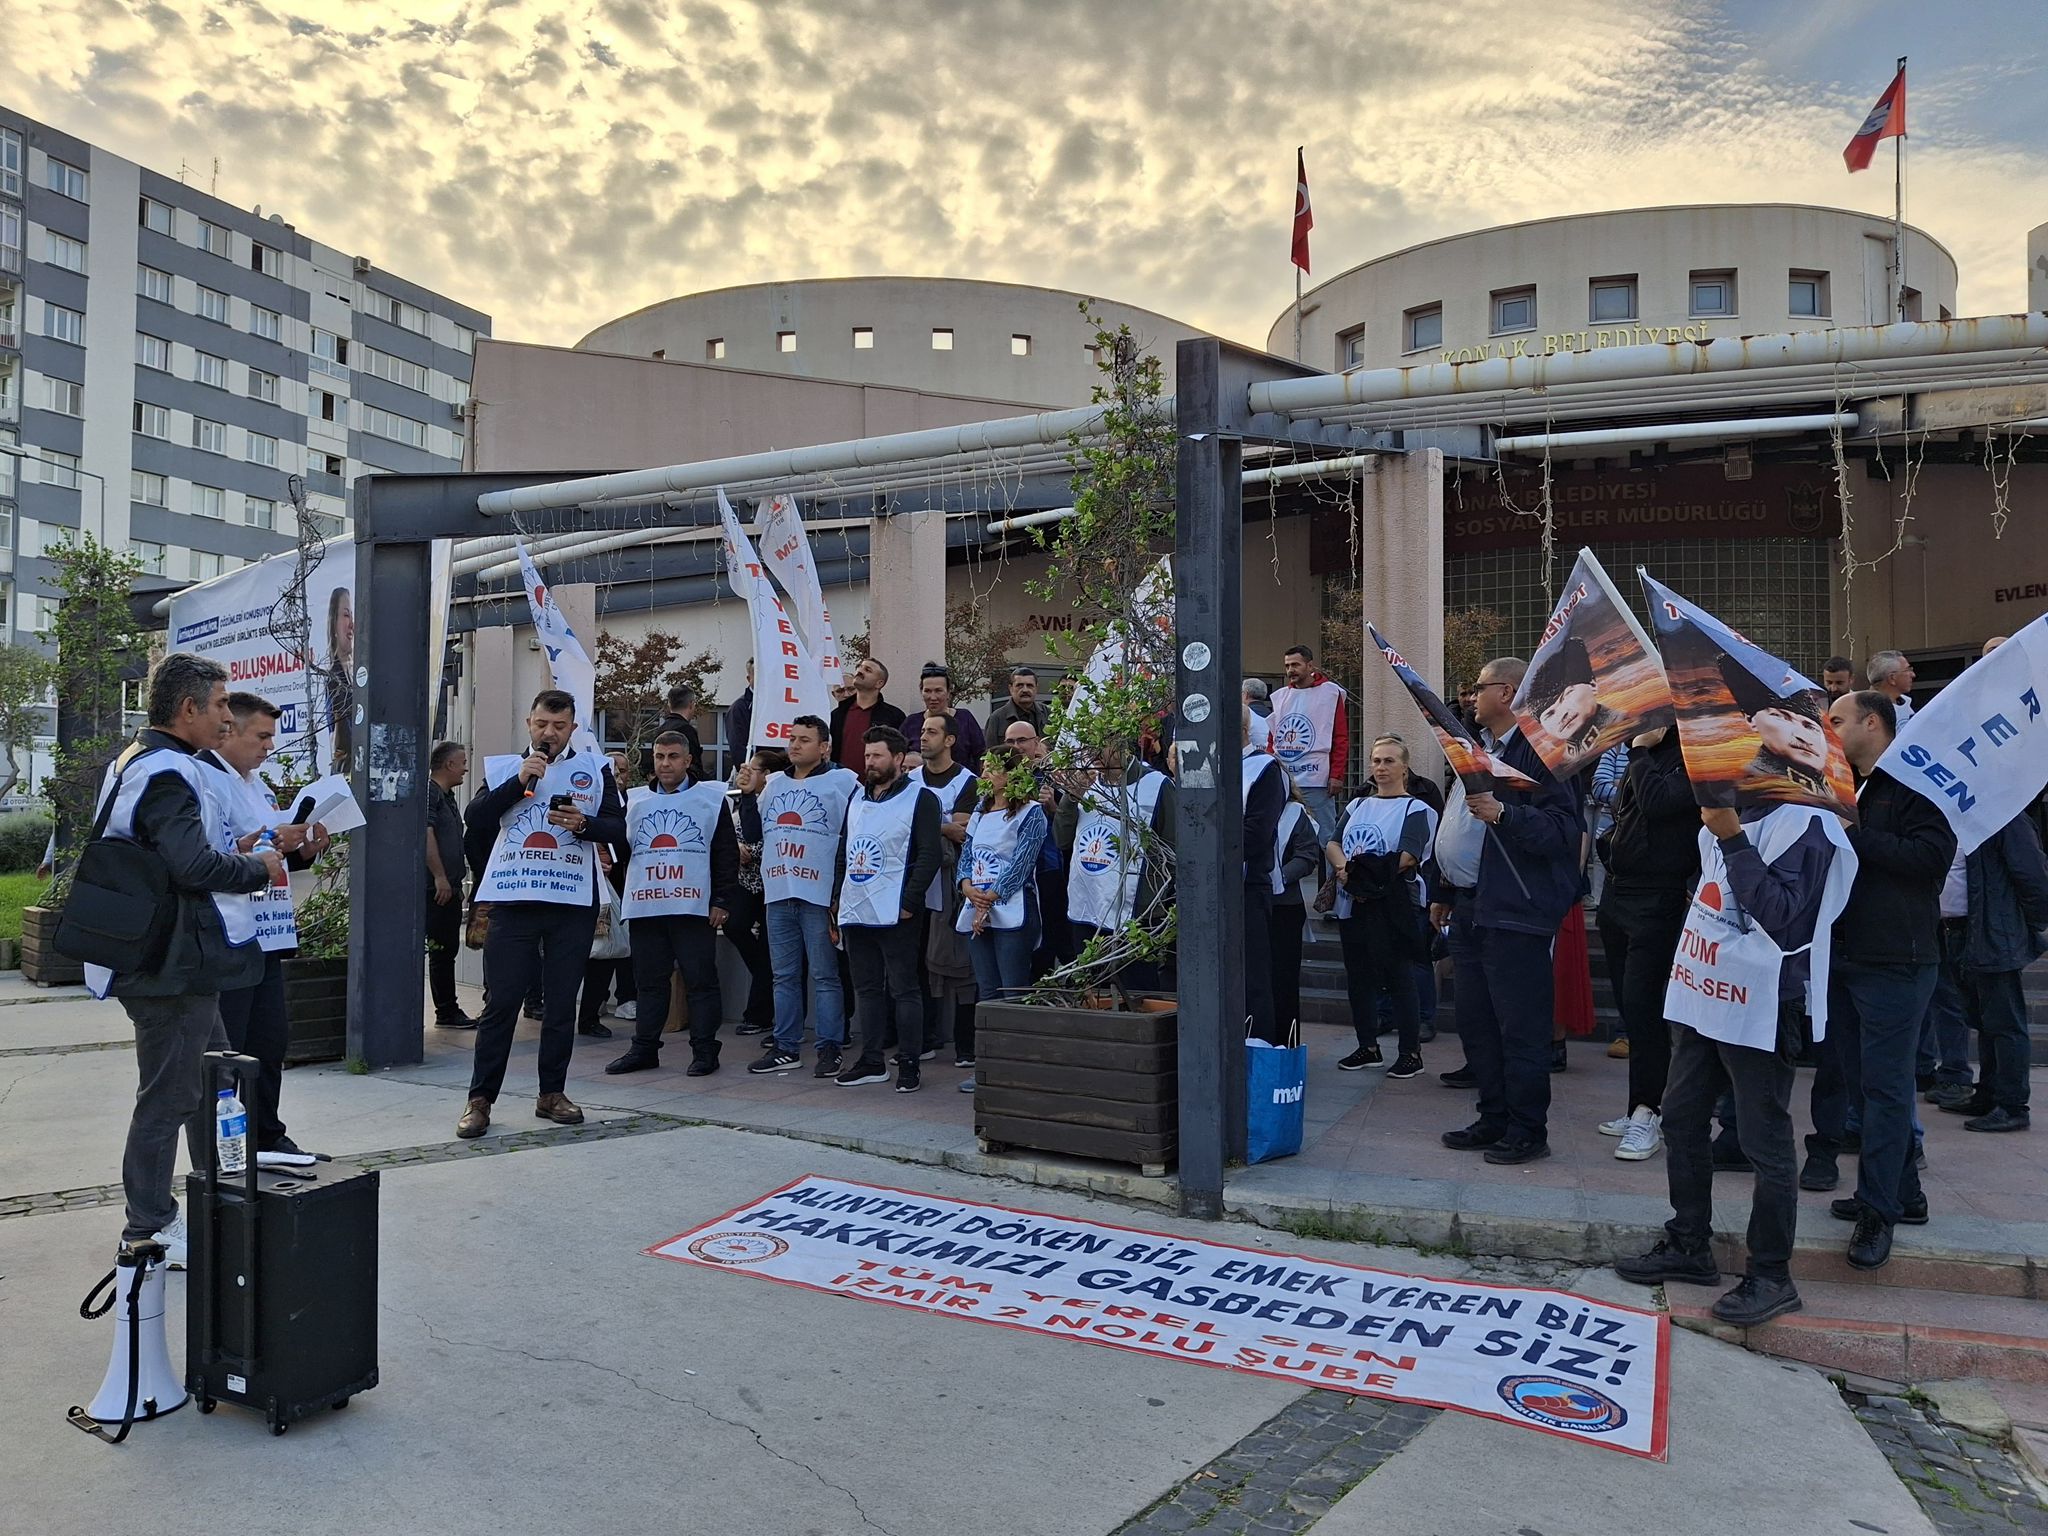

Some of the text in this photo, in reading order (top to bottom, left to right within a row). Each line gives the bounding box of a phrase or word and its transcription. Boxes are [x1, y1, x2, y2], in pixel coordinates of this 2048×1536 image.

[1543, 320, 1709, 353] BELEDİYESİ
[1454, 499, 1767, 537] SOSYAL ŞLER MÜDÜRLÜĞÜ
[281, 709, 295, 730] 07
[1900, 744, 1977, 814] SEN
[500, 850, 516, 864] TÜM
[519, 850, 557, 861] YEREL
[564, 853, 584, 865] SEN
[776, 838, 806, 859] TÜM
[491, 867, 584, 882] Emek Hareketinde
[645, 862, 684, 881] TÜM
[496, 879, 577, 893] Güçlü Bir Mevzi
[631, 887, 701, 901] YEREL-SEN
[1681, 928, 1720, 966] TÜM
[1272, 1080, 1304, 1104] mavi
[772, 1187, 1638, 1353] ALINTERİ DÖKEN BİZ, EMEK VEREN BİZ,
[735, 1209, 1631, 1386] HAKKIMIZI GASBEDEN SİZ!
[856, 1259, 1417, 1371] TÜM YEREL SEN
[829, 1272, 1398, 1389] İZMİR 2 NOLU ŞUBE
